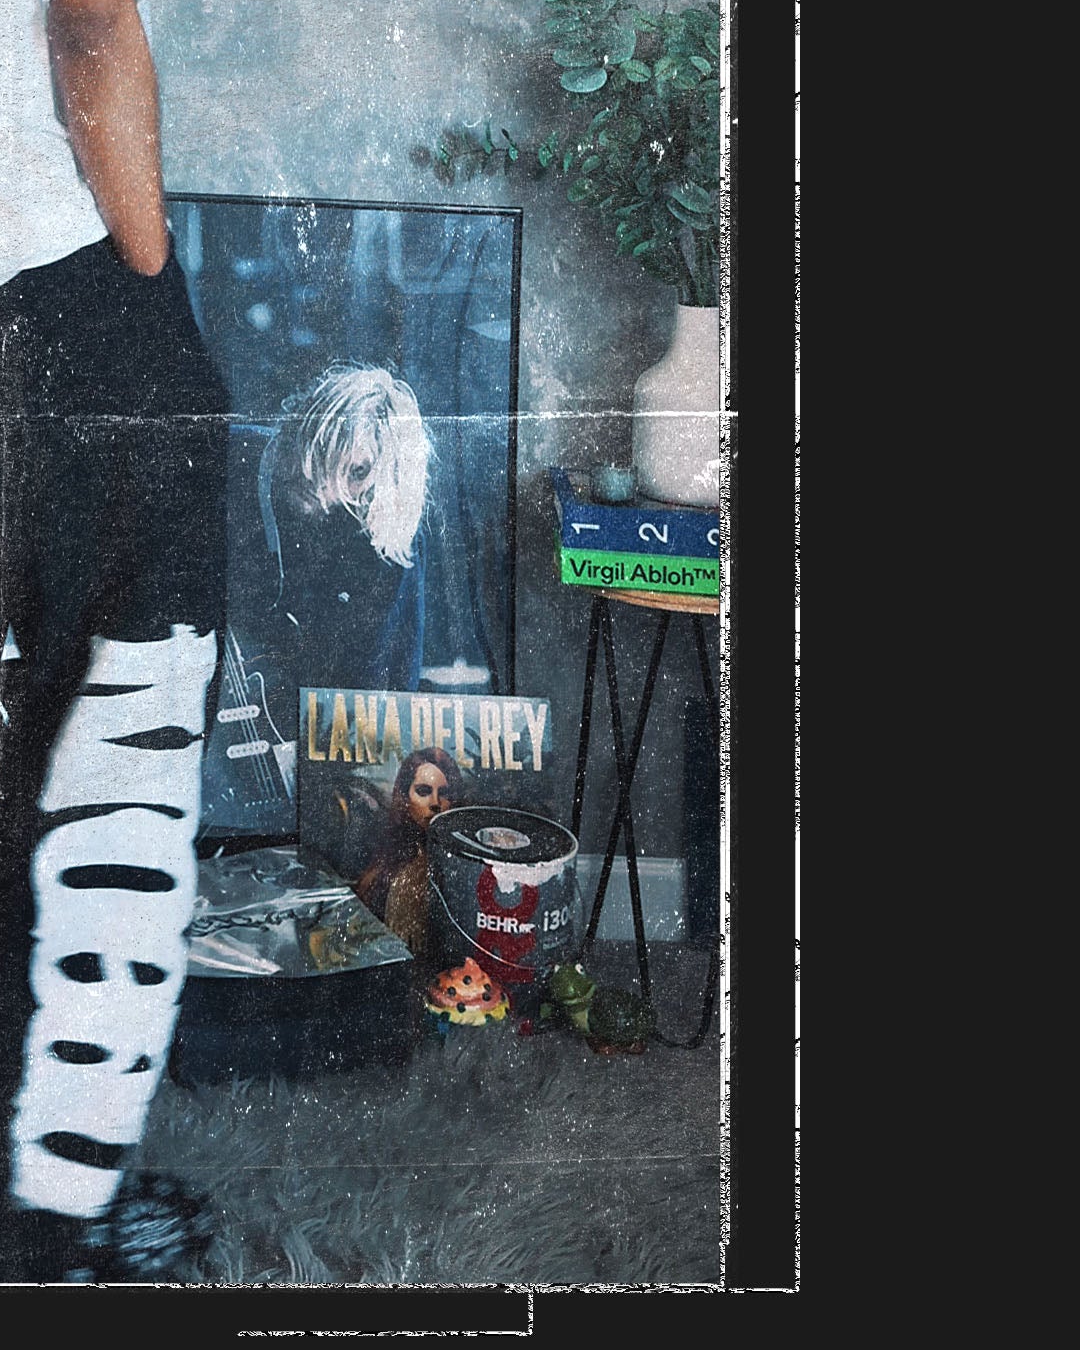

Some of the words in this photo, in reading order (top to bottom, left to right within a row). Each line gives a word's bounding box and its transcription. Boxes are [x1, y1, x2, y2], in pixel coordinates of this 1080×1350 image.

[638, 522, 669, 544] 2
[570, 557, 626, 585] Virgil
[307, 691, 406, 765] LANA
[410, 696, 475, 769] DEL
[478, 700, 549, 772] REY
[476, 911, 519, 934] BEHR
